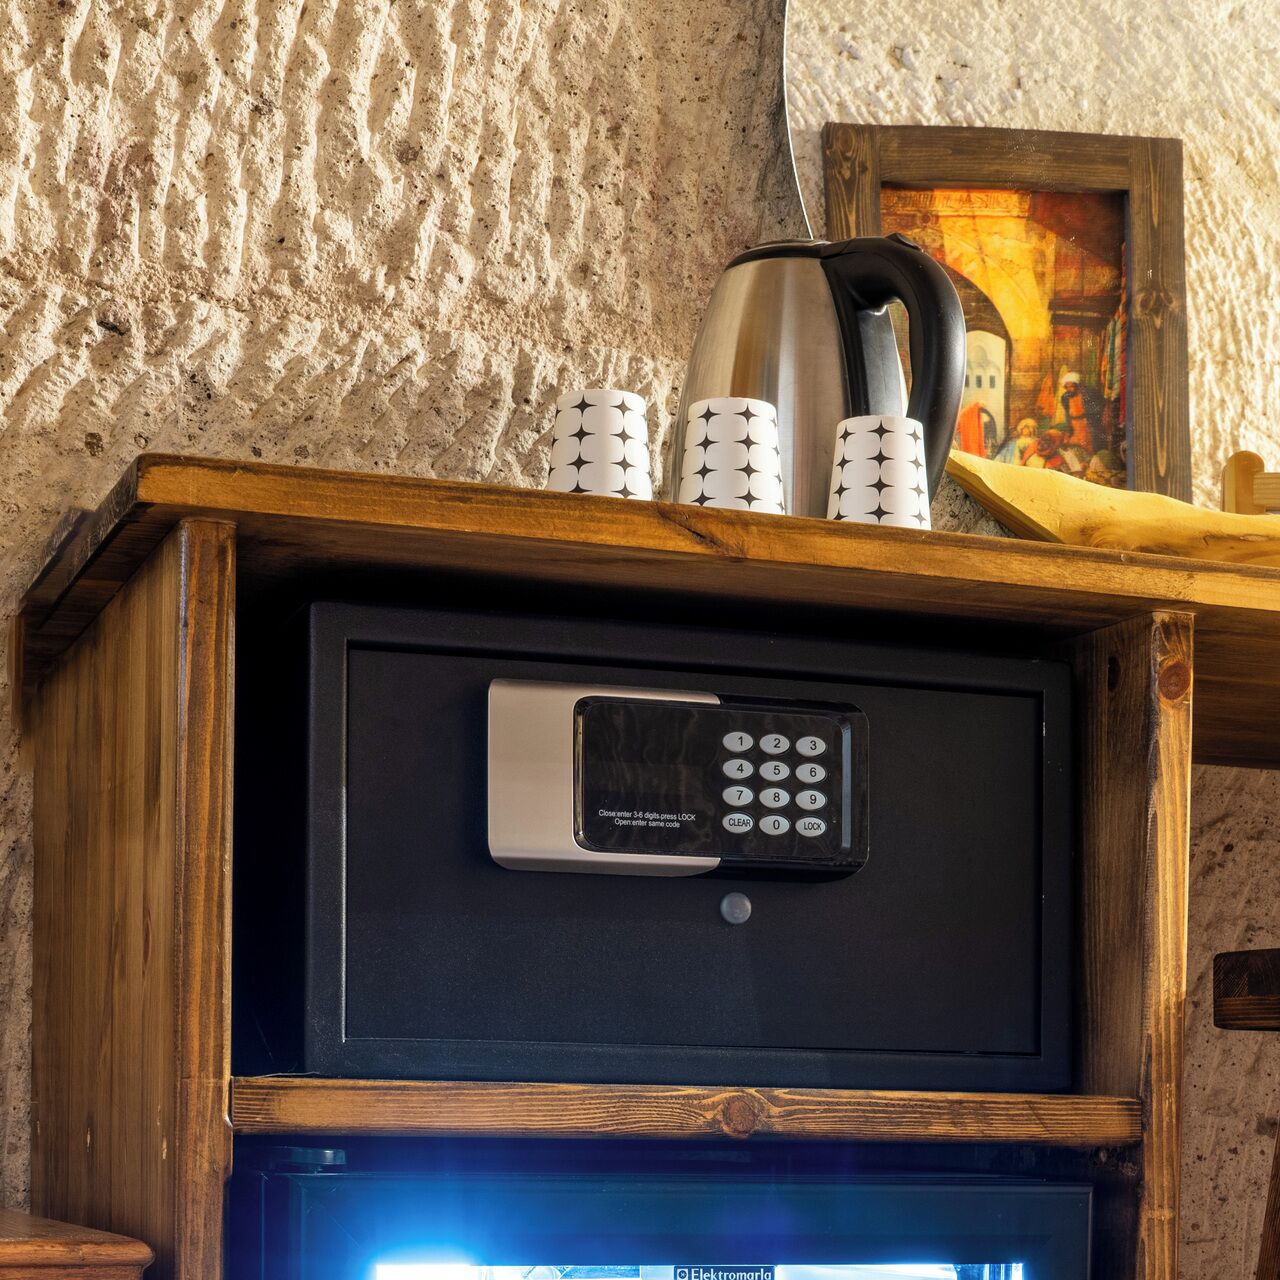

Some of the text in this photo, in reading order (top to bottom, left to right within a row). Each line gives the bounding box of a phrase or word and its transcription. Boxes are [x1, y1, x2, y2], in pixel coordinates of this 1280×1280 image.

[738, 735, 817, 751] 1 2 3
[736, 763, 817, 778] 4 5 6
[736, 790, 817, 805] 7 8 9
[648, 820, 665, 828] same
[665, 820, 680, 828] code
[678, 813, 696, 821] LOCK
[728, 817, 751, 828] CLEAR
[803, 821, 822, 831] LOCK
[691, 1268, 772, 1280] Elektromarla
